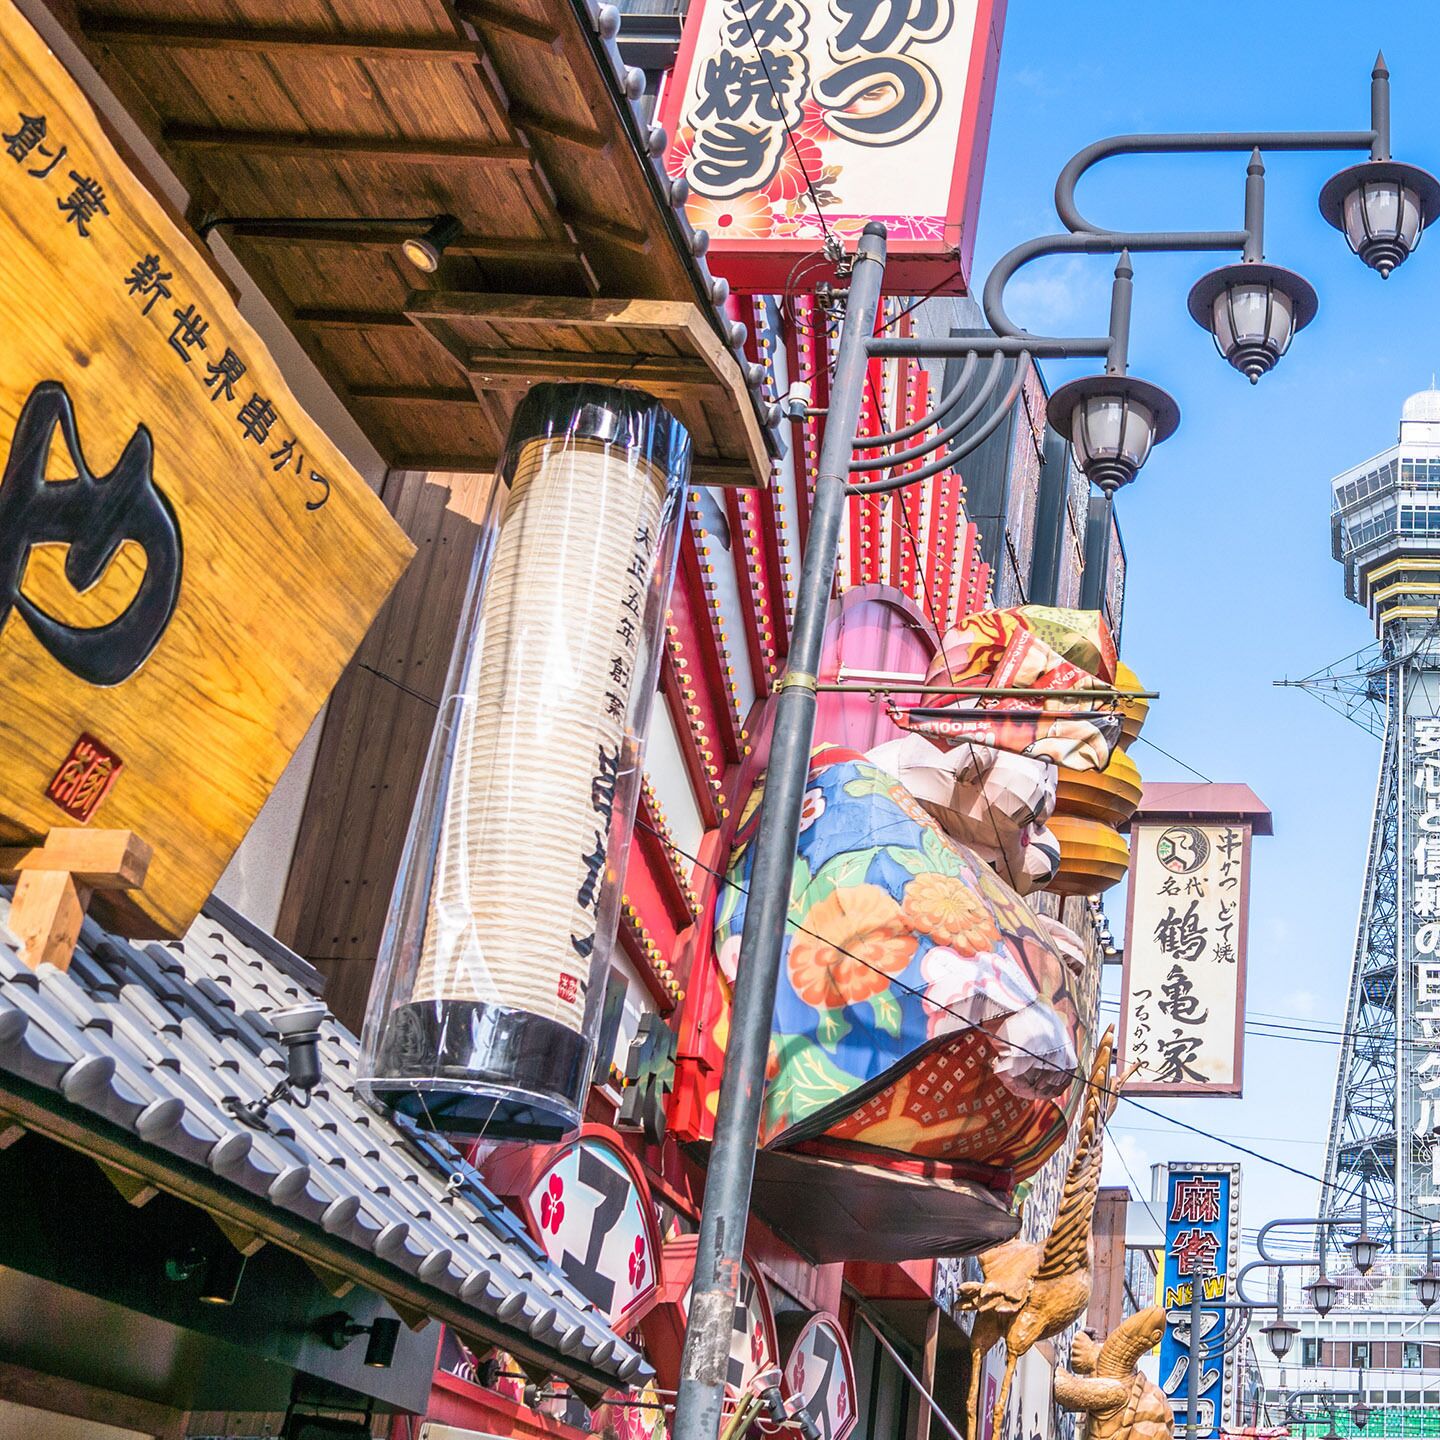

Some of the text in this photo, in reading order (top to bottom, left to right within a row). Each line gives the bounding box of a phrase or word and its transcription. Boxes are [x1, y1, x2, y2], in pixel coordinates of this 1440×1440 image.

[2, 110, 332, 512] 創業 新世界串かつ
[1156, 876, 1209, 898] 名代
[1153, 900, 1210, 1084] 鶴亀家
[1169, 1176, 1221, 1277] 麻雀
